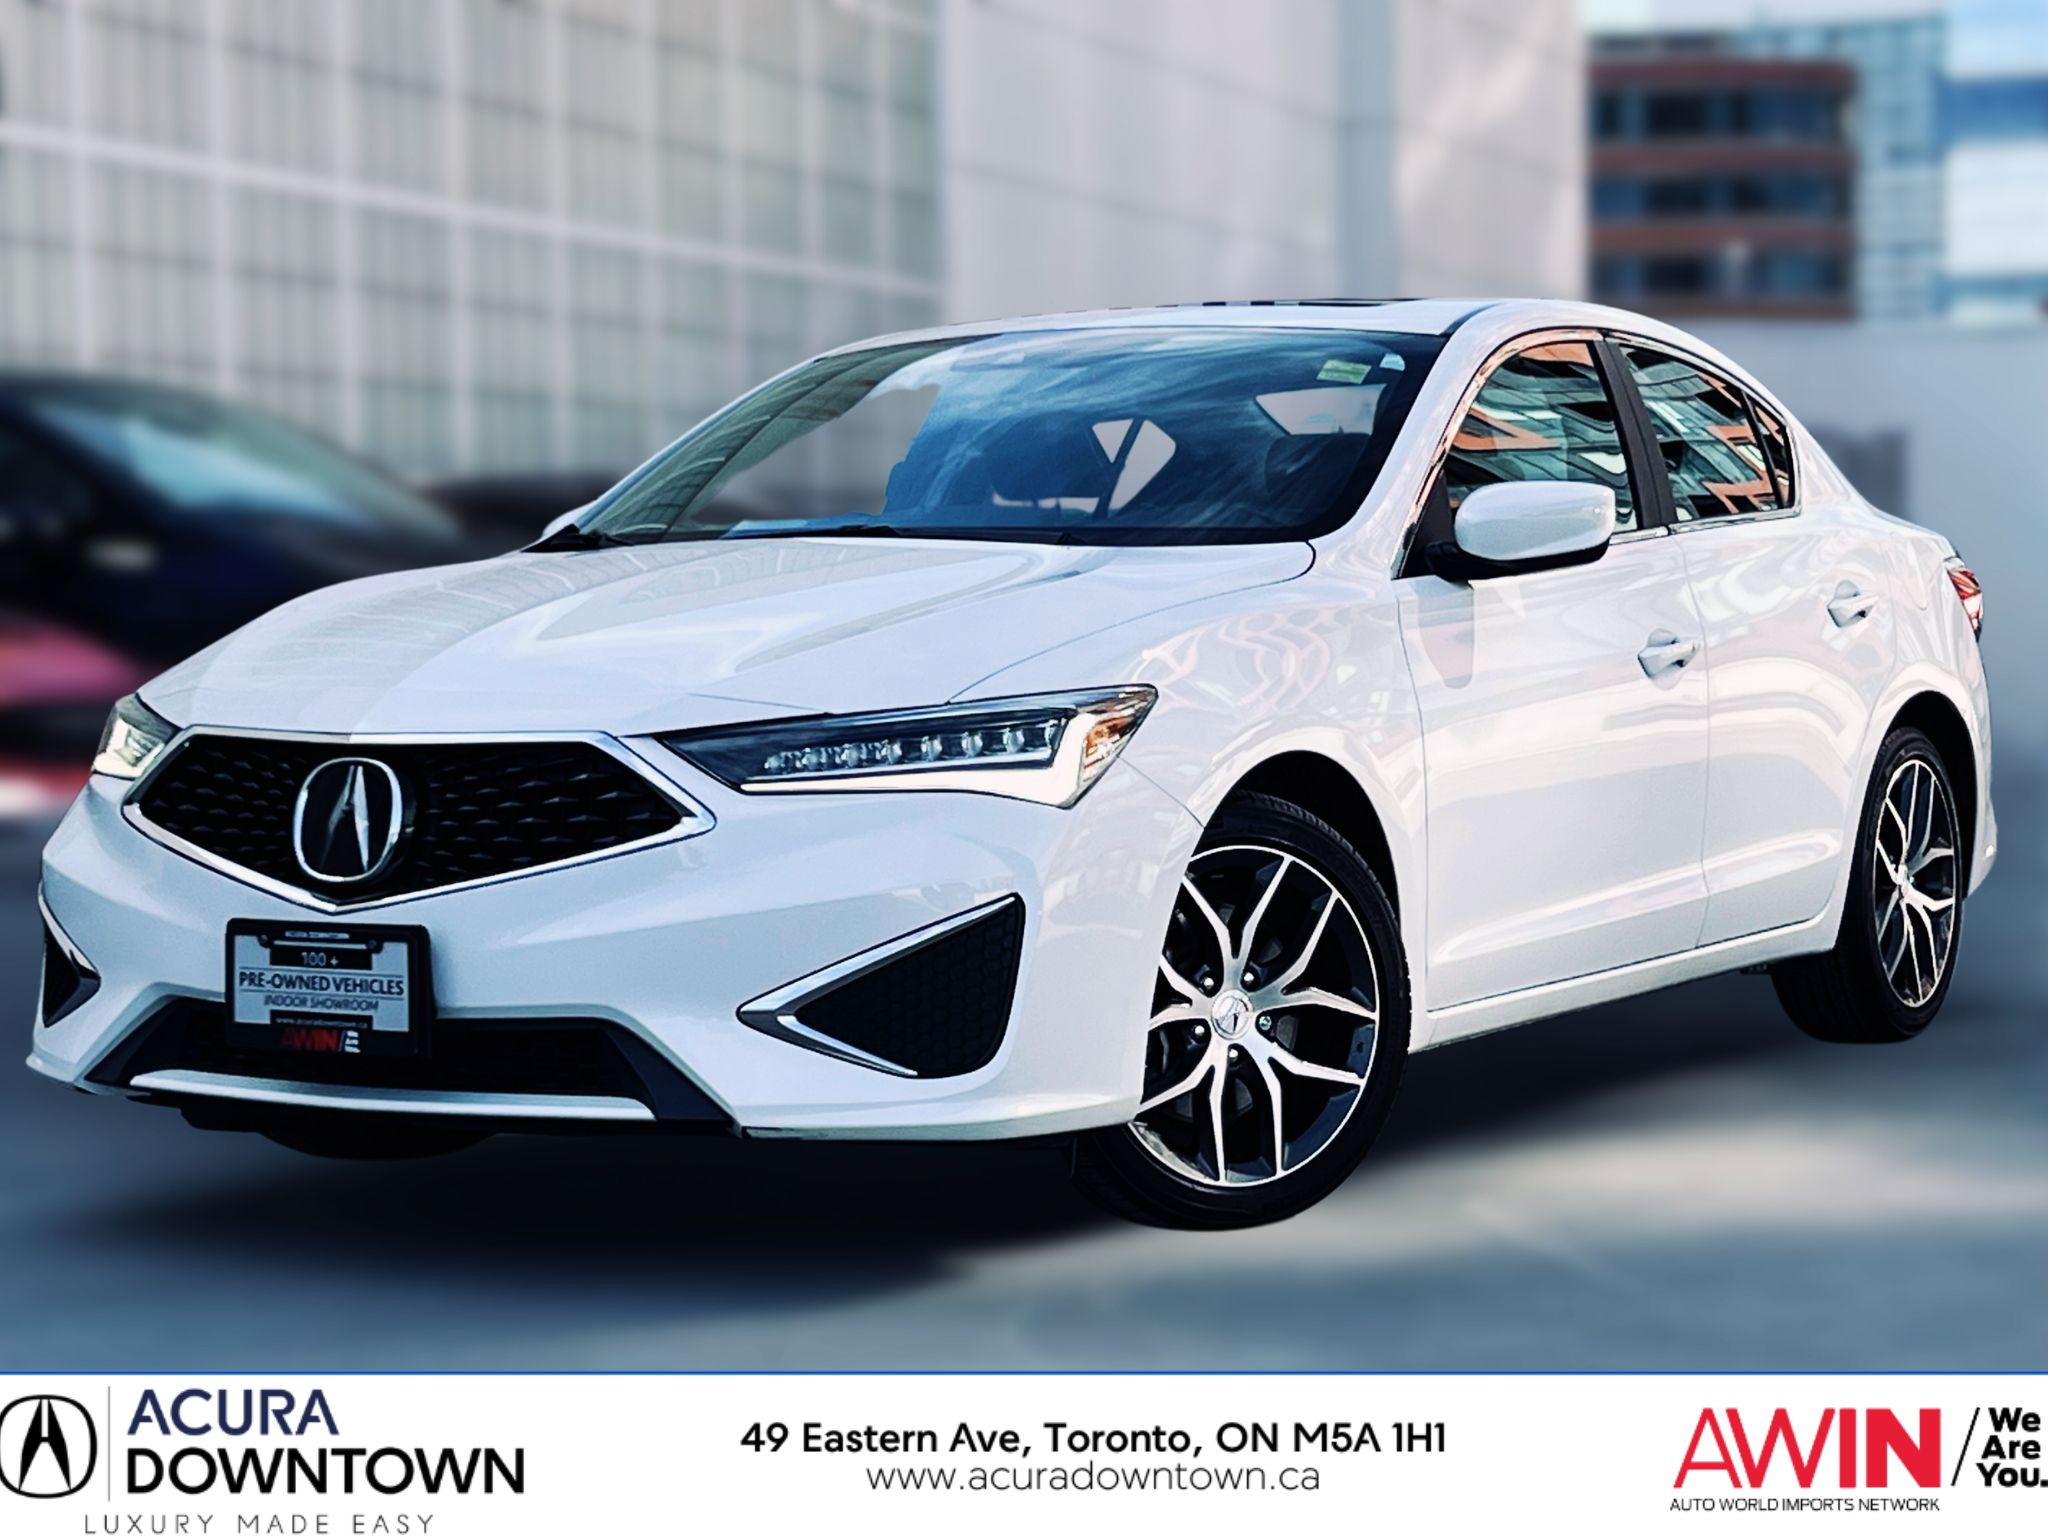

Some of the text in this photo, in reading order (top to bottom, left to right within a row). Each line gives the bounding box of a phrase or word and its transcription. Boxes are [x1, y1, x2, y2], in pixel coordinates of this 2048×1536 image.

[301, 951, 327, 967] 100
[239, 971, 404, 996] PRE-OWNED VEHICLES
[264, 994, 379, 1012] INDOOR SHOWROOM
